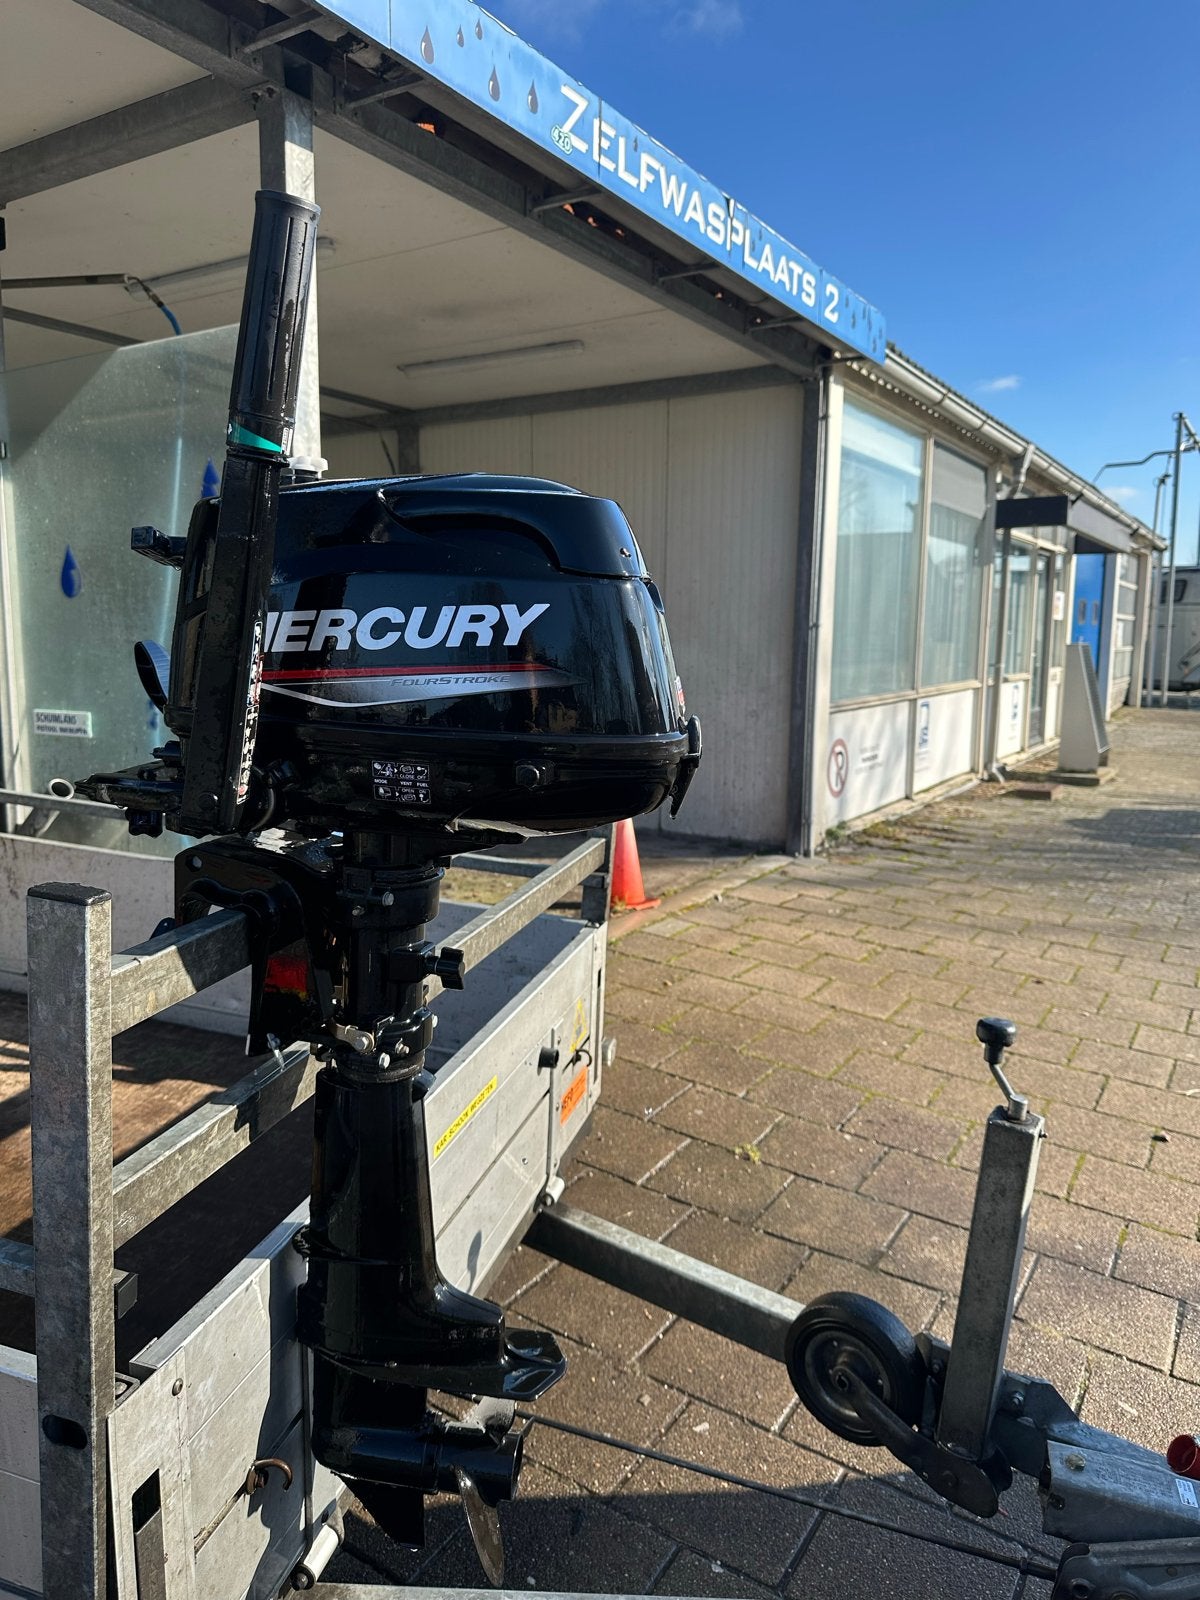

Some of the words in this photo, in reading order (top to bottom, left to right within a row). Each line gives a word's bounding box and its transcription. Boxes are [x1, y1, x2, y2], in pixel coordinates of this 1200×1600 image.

[561, 84, 816, 308] ZELFWASPLAATS
[825, 283, 839, 323] 2
[391, 674, 511, 687] FOURSTROKE
